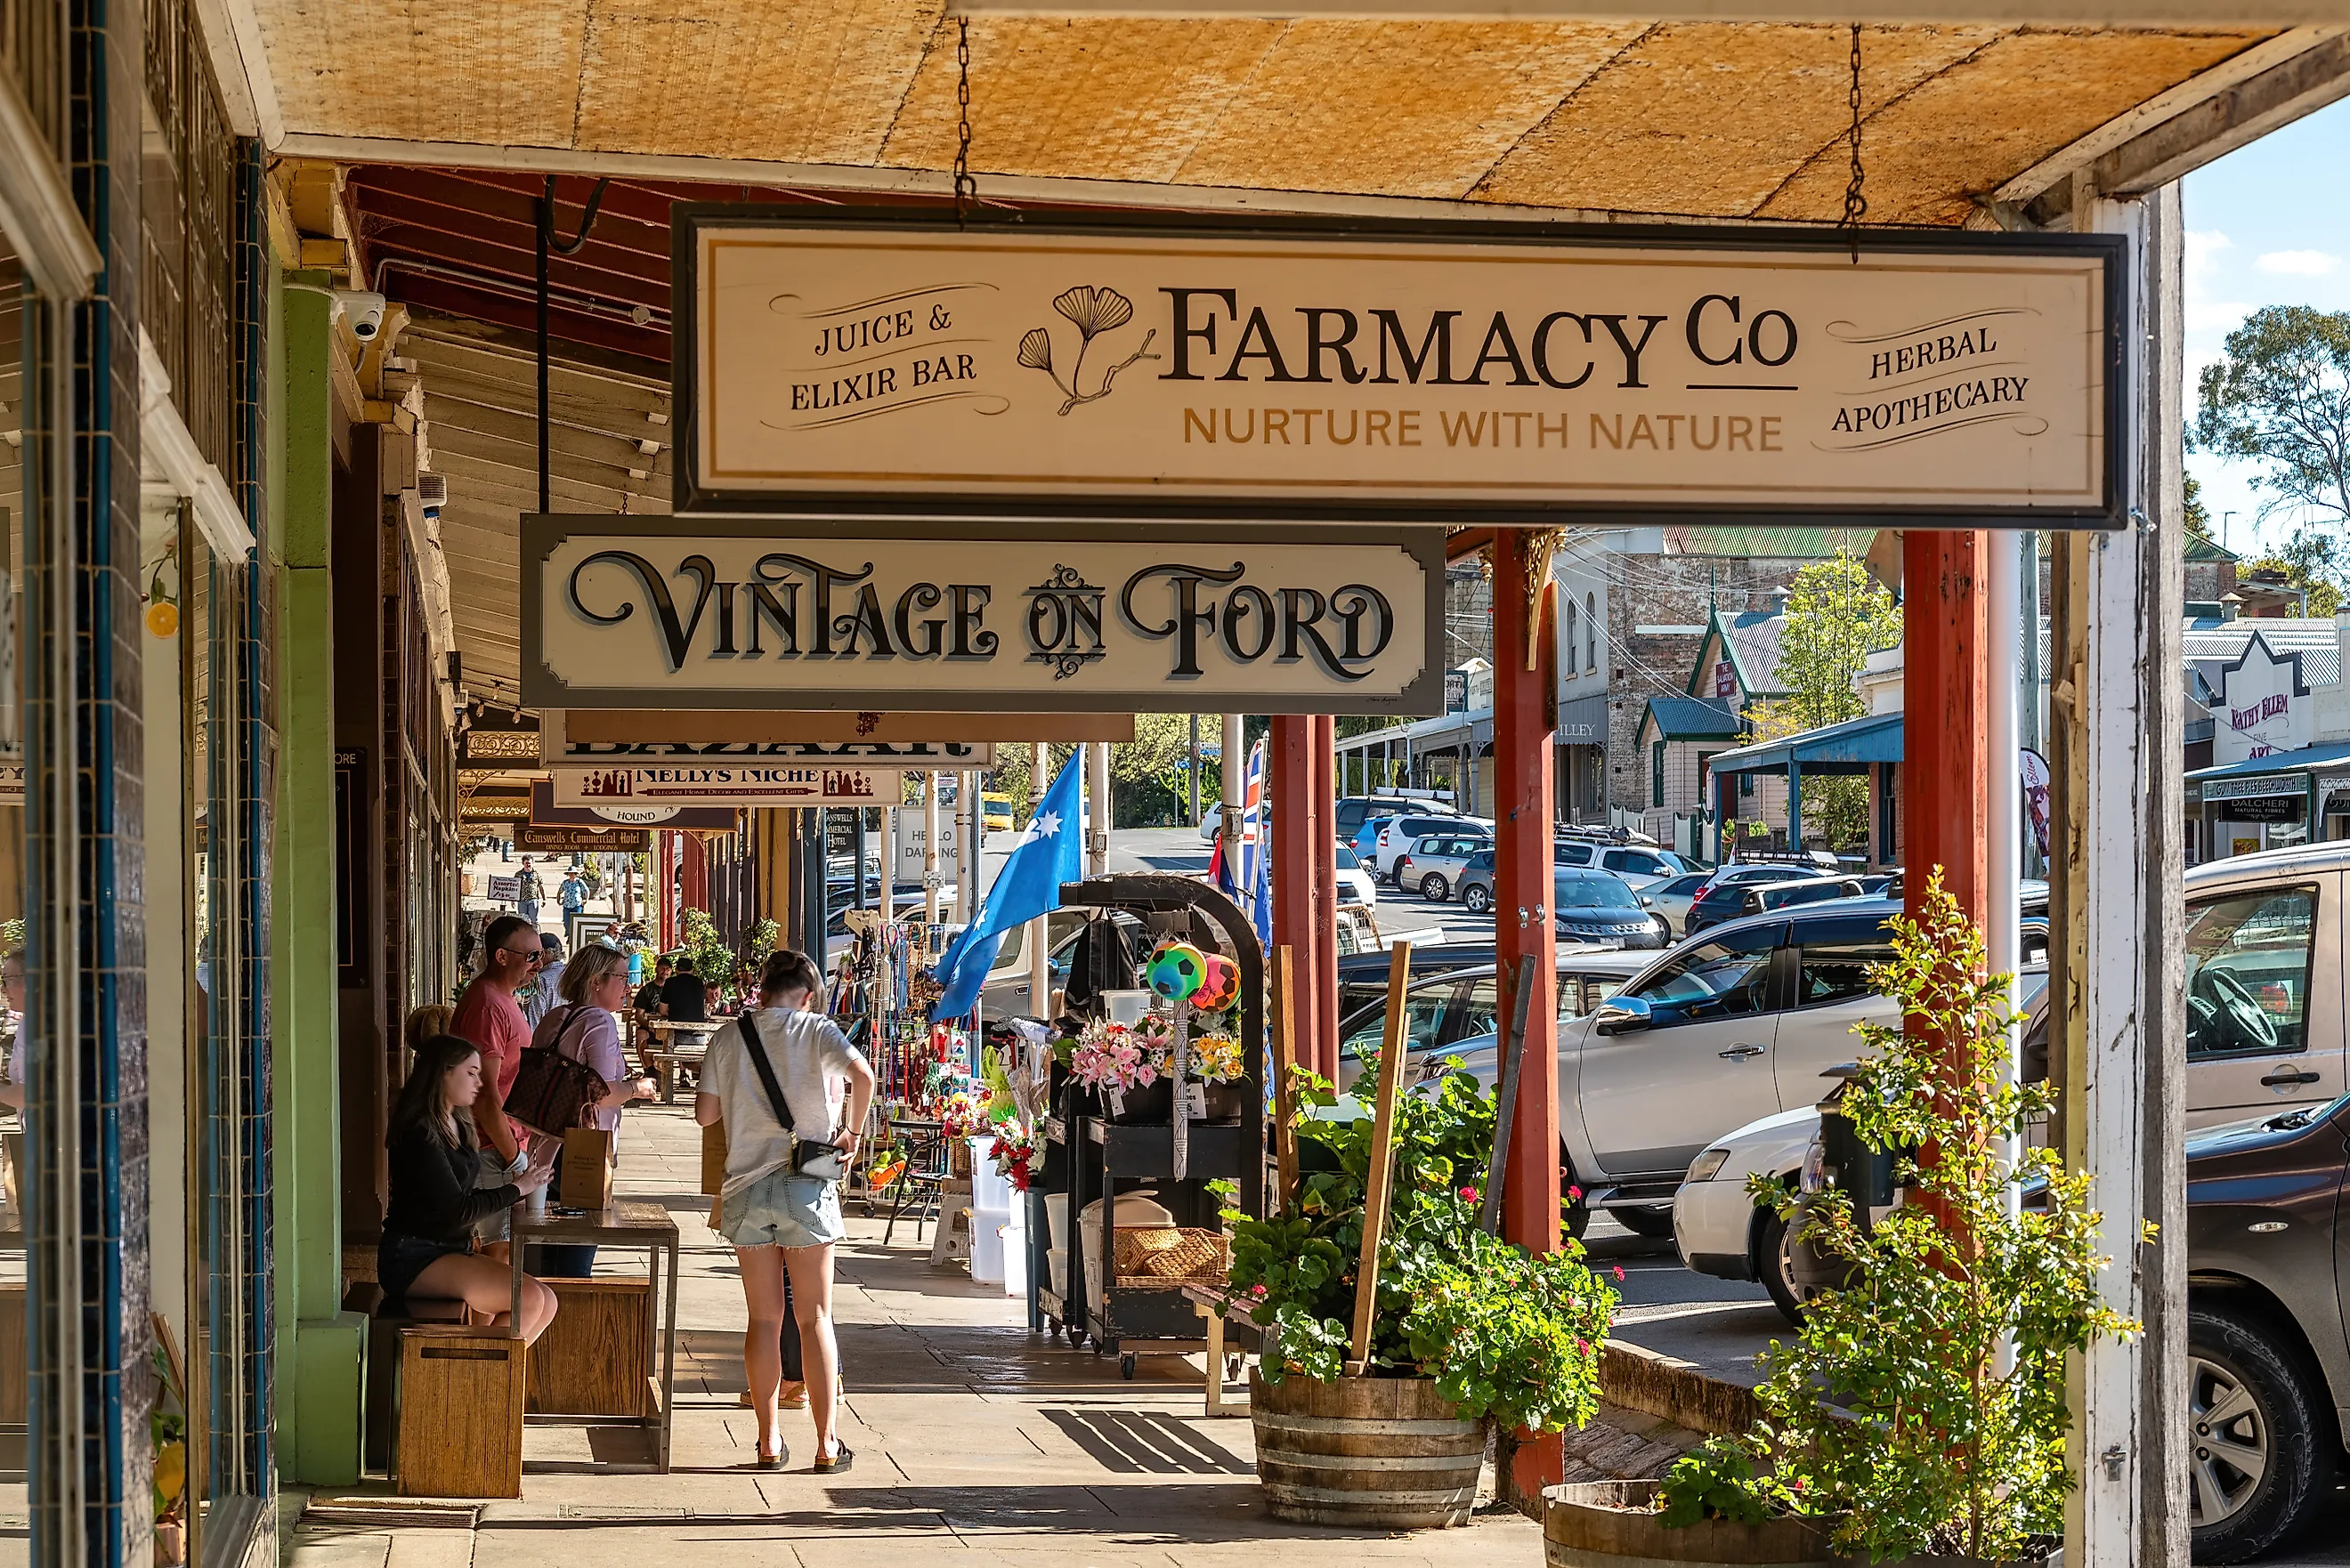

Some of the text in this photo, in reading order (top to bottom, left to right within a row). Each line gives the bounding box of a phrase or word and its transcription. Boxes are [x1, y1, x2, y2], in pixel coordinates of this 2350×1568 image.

[814, 303, 952, 356] JUICE &
[1158, 287, 1668, 390] FARMACY
[1869, 327, 1998, 381] HERBAL
[790, 353, 977, 413] ELIXIR BAR
[1831, 376, 2030, 433] APOTHECARY
[1184, 408, 1785, 452] NURTURE WITH NATURE
[566, 548, 1394, 682] VINTAGE ON FORD
[1554, 723, 1595, 737] ILLEY
[2230, 701, 2260, 731] KATHY
[635, 770, 820, 783] NELLY'S NICHE
[617, 811, 656, 821] HOUND
[826, 813, 854, 822] ANSWELLS
[2231, 799, 2289, 808] DALCHERI
[571, 830, 616, 844] Commercial
[620, 831, 640, 845] Hotel
